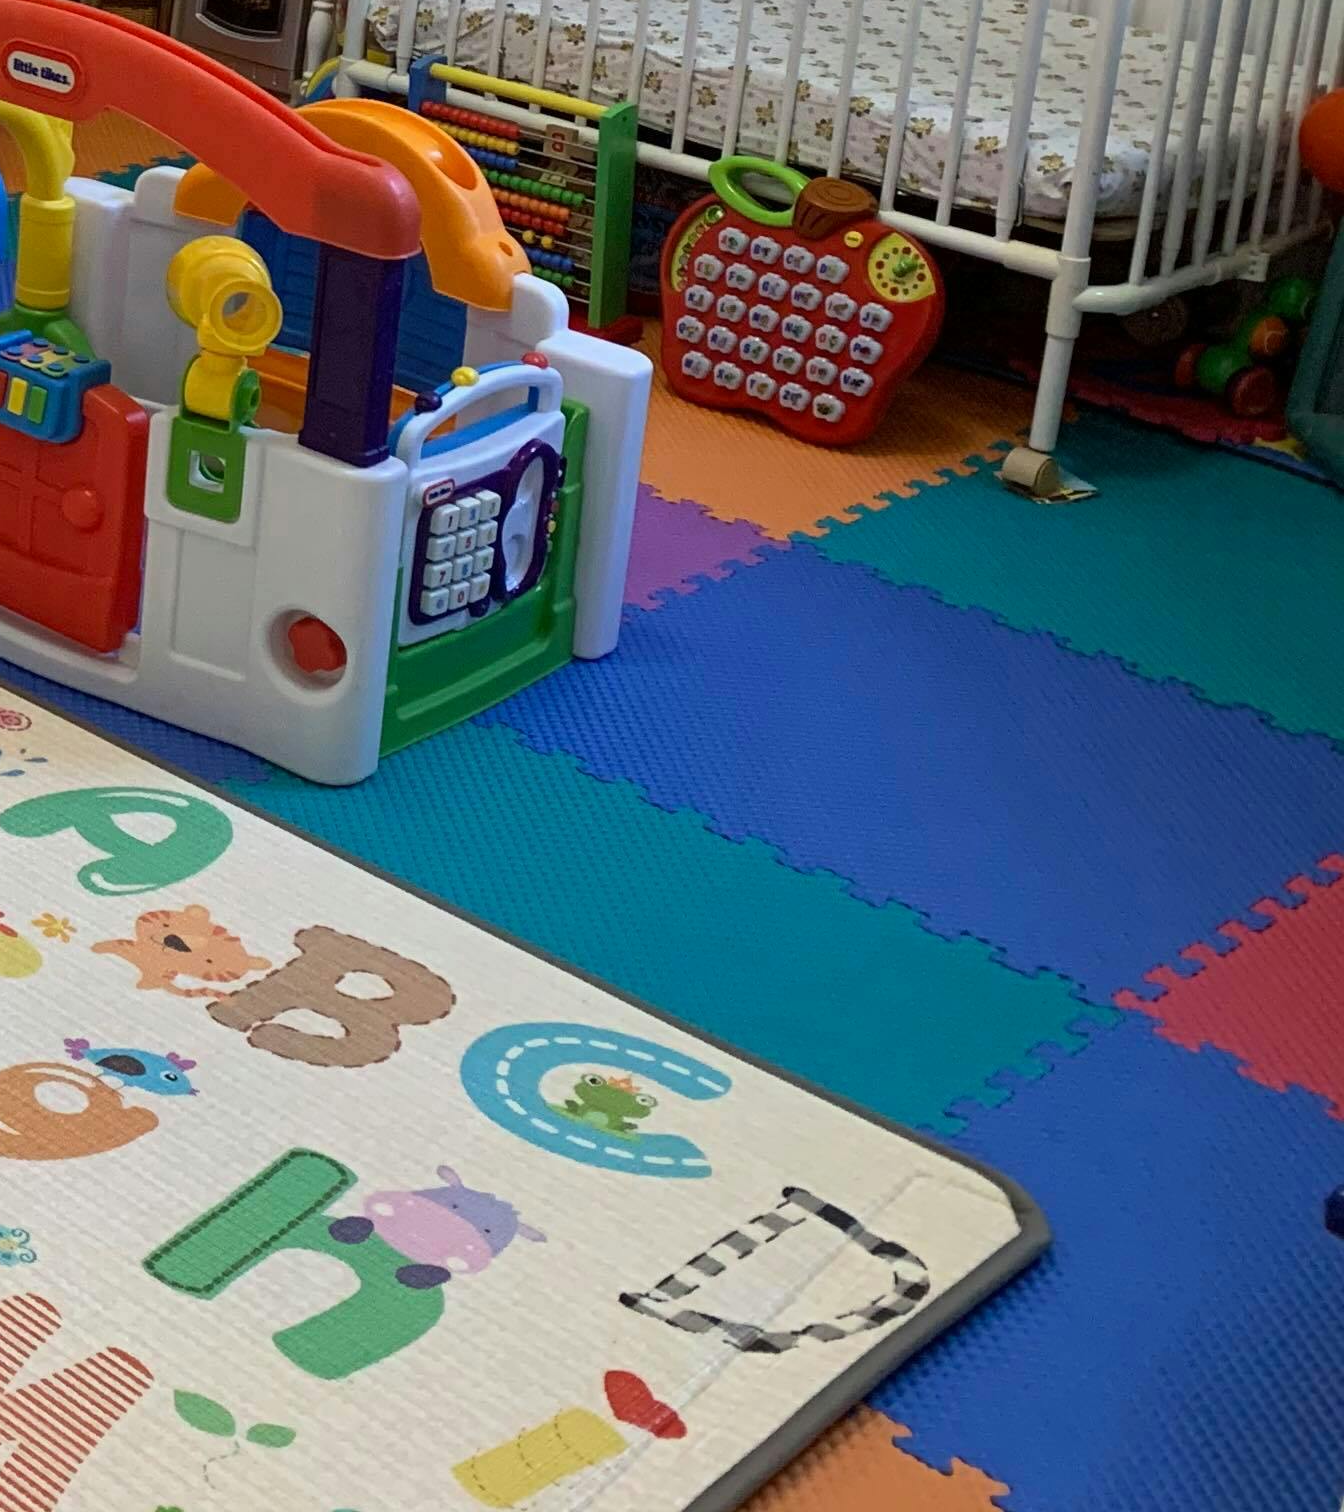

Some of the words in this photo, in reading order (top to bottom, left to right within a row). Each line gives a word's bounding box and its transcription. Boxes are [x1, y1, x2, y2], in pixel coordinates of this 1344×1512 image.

[13, 57, 38, 77] little
[40, 66, 69, 86] tikes
[207, 923, 457, 1068] B
[459, 1020, 733, 1180] C
[143, 1147, 447, 1381] h
[618, 1185, 931, 1355] D
